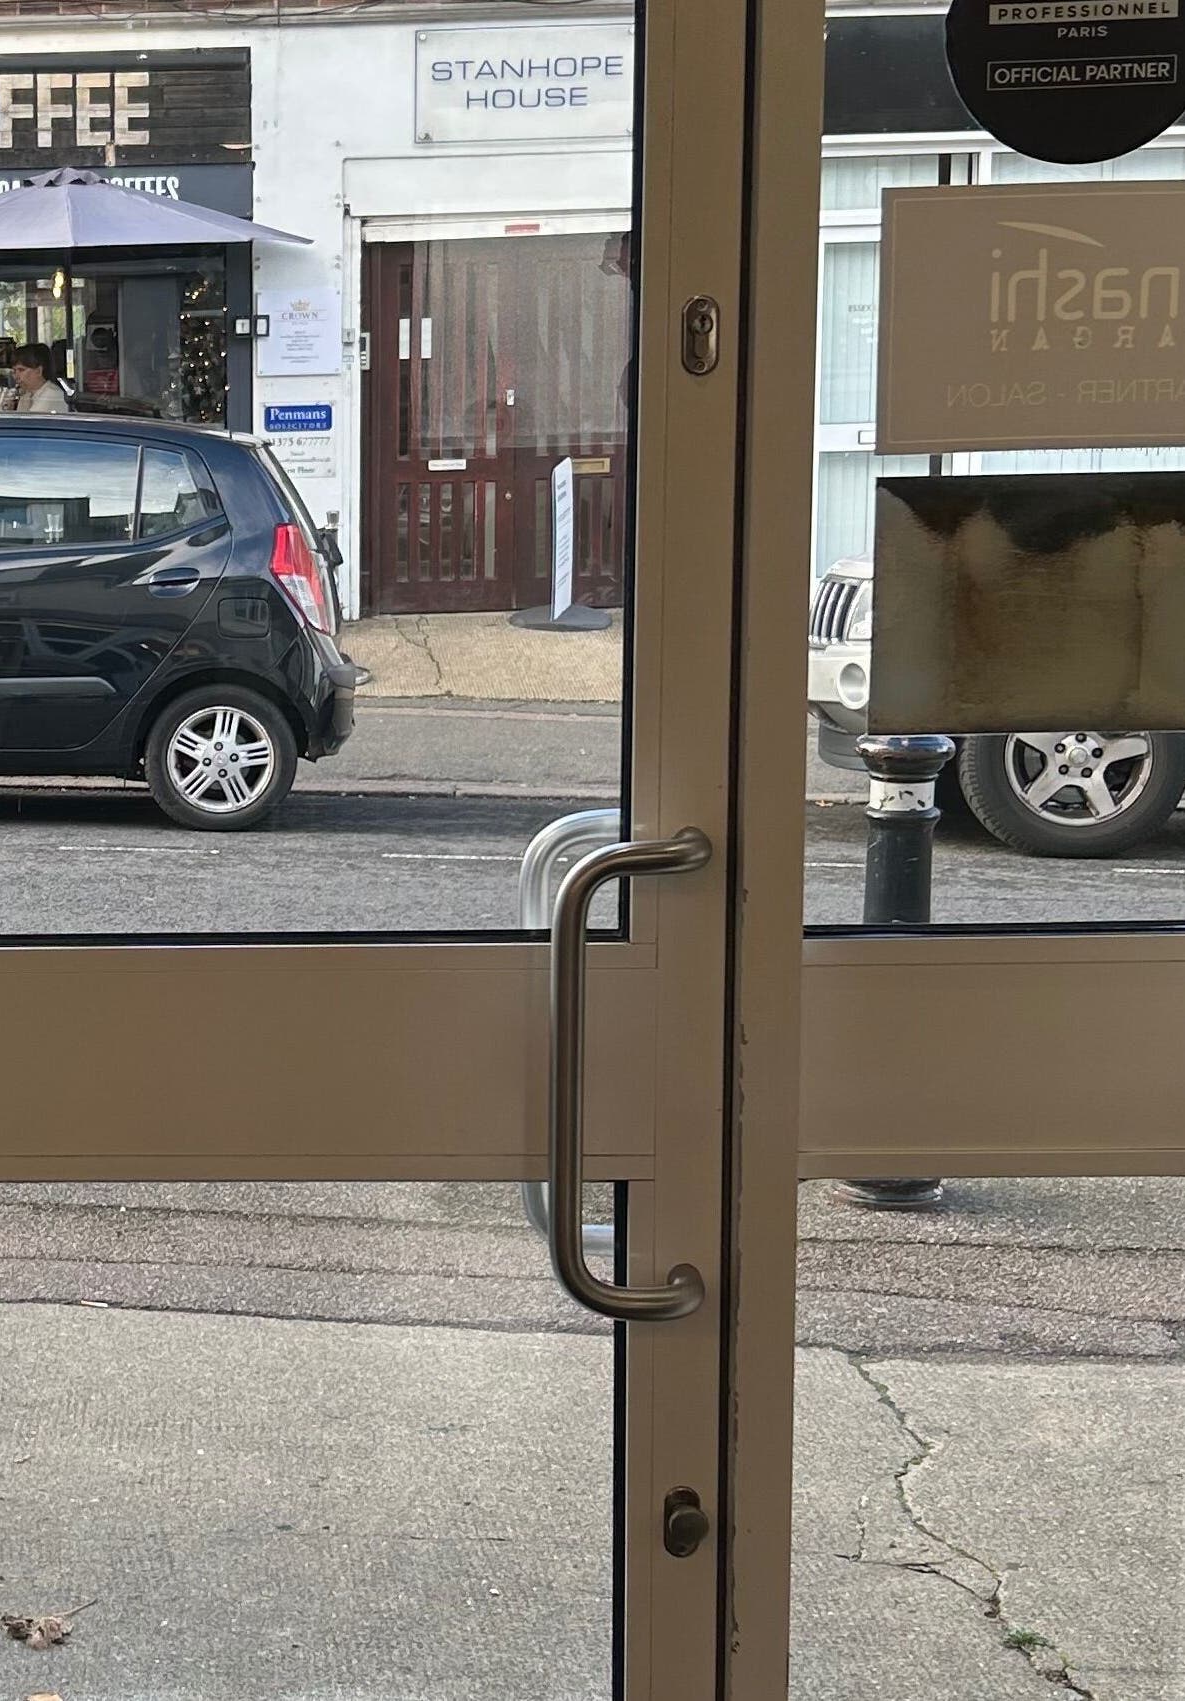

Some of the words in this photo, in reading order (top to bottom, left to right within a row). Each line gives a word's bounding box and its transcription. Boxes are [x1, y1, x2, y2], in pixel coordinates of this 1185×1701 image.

[998, 2, 1170, 20] PROFESSIONNEL
[1057, 26, 1109, 38] PARIS
[431, 56, 623, 81] STANHOPE
[994, 66, 1081, 84] OFFICIAL
[1085, 62, 1170, 80] PARTNER
[466, 87, 588, 109] HOUSE
[270, 408, 327, 421] Penmans
